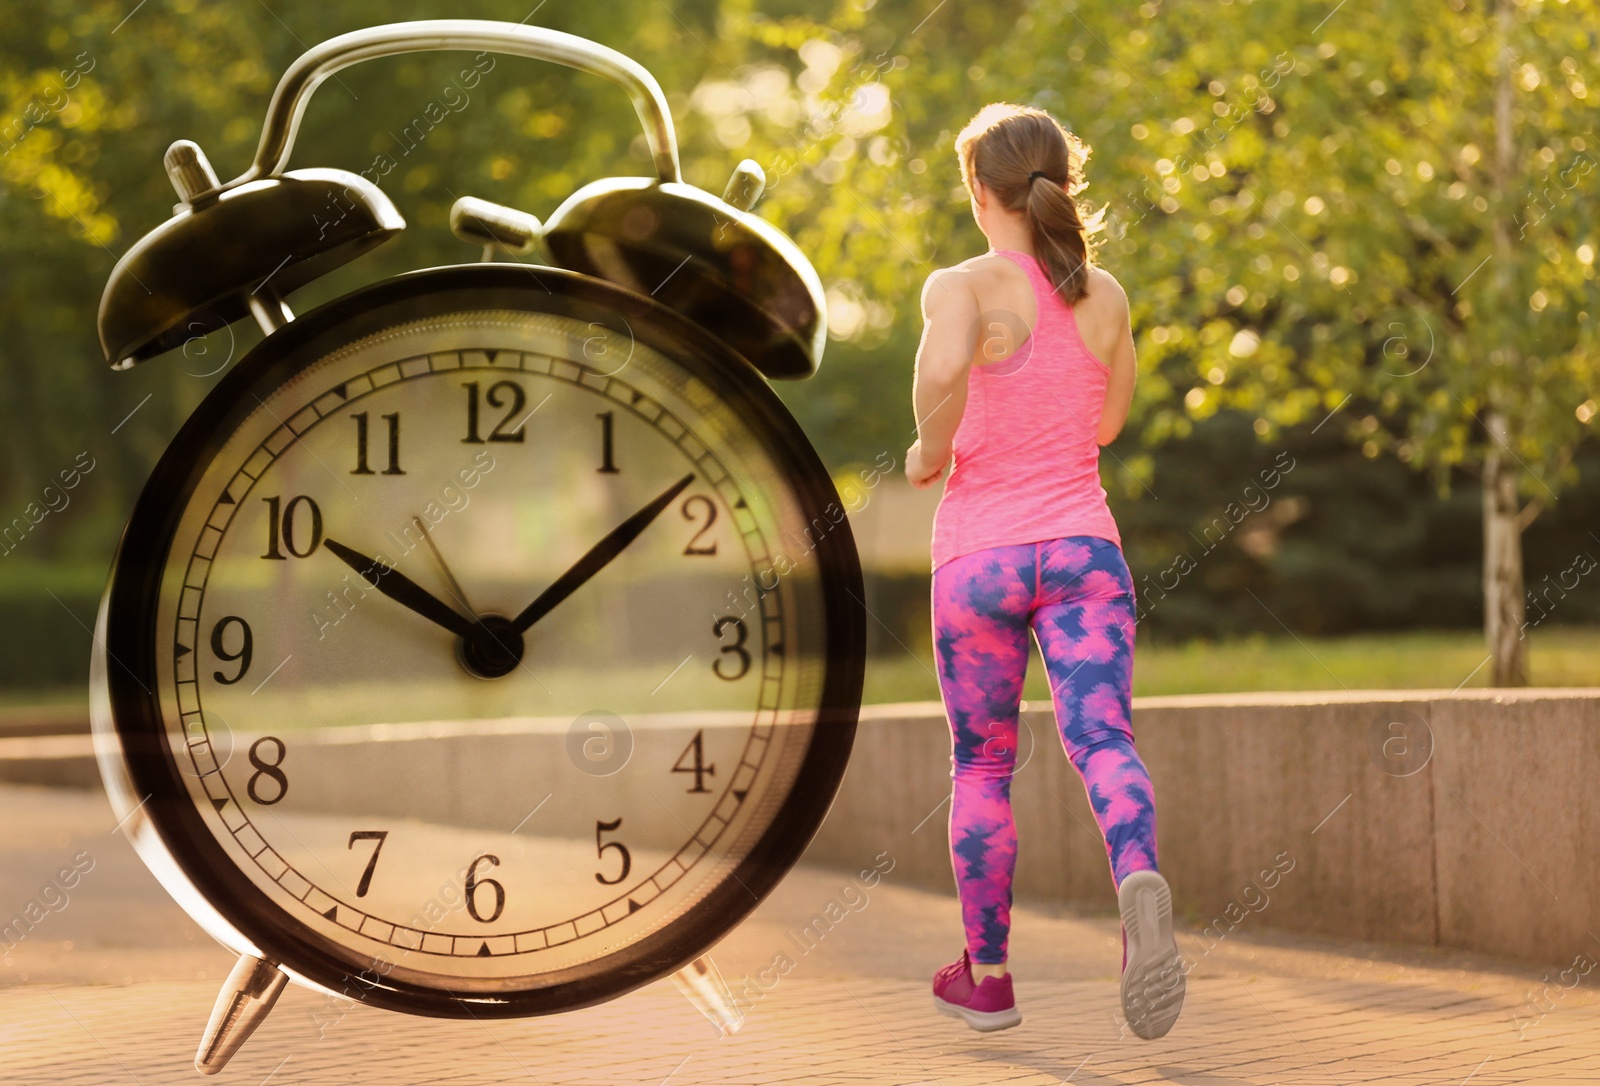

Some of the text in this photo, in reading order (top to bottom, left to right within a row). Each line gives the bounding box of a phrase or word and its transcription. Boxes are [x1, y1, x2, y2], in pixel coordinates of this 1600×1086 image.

[349, 410, 406, 476] 11
[460, 381, 527, 444] 12
[595, 410, 620, 475] 1
[260, 494, 324, 560] 10
[680, 494, 719, 557] 2
[210, 615, 254, 686] 9
[712, 615, 753, 681] 3
[246, 736, 289, 806] 8
[670, 730, 717, 794] 4
[348, 830, 389, 898] 7
[595, 817, 632, 886] 5
[464, 854, 506, 924] 6
